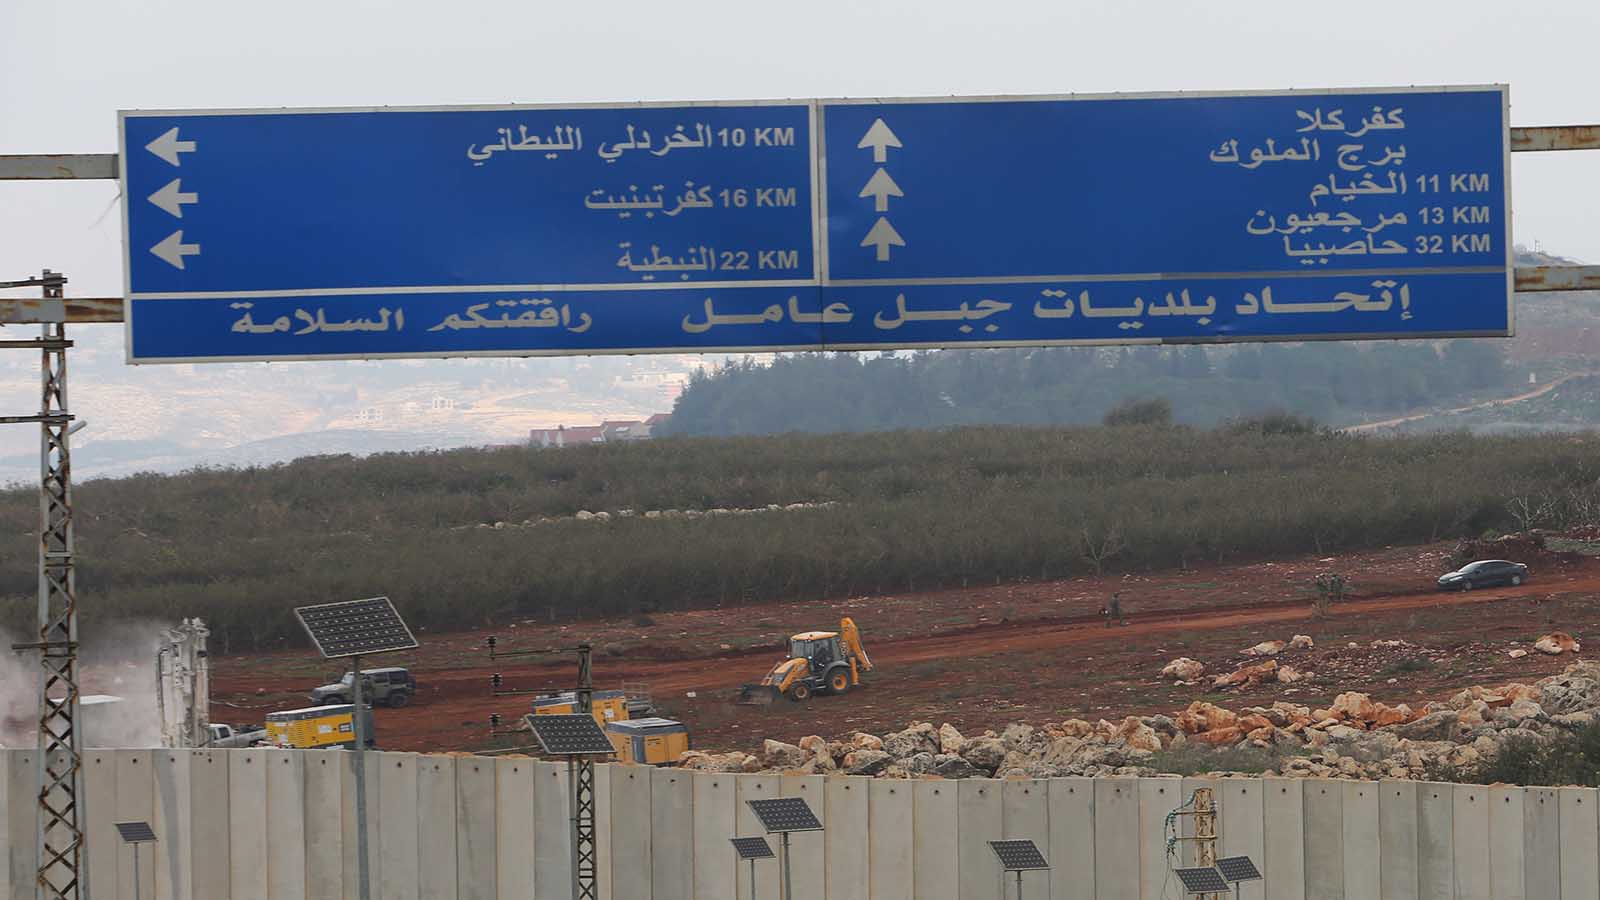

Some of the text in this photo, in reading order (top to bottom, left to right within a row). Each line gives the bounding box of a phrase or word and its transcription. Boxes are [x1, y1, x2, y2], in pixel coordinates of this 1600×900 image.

[467, 122, 795, 167] 10 KM الخردلي الليطاني
[1209, 137, 1406, 172] برج الملوك
[719, 187, 747, 208] 16
[756, 187, 796, 207] KM
[1309, 170, 1489, 207] 11 KM الخيام
[1246, 206, 1490, 235] 13 KM مرجعيون
[617, 242, 798, 281] 22 KM النبطية
[1283, 232, 1491, 265] 32 KM حاصبيا
[230, 297, 593, 335] رافقتكم السلامة
[682, 295, 853, 333] عامل
[874, 293, 1012, 333] جبل
[1033, 288, 1217, 330] بلديات
